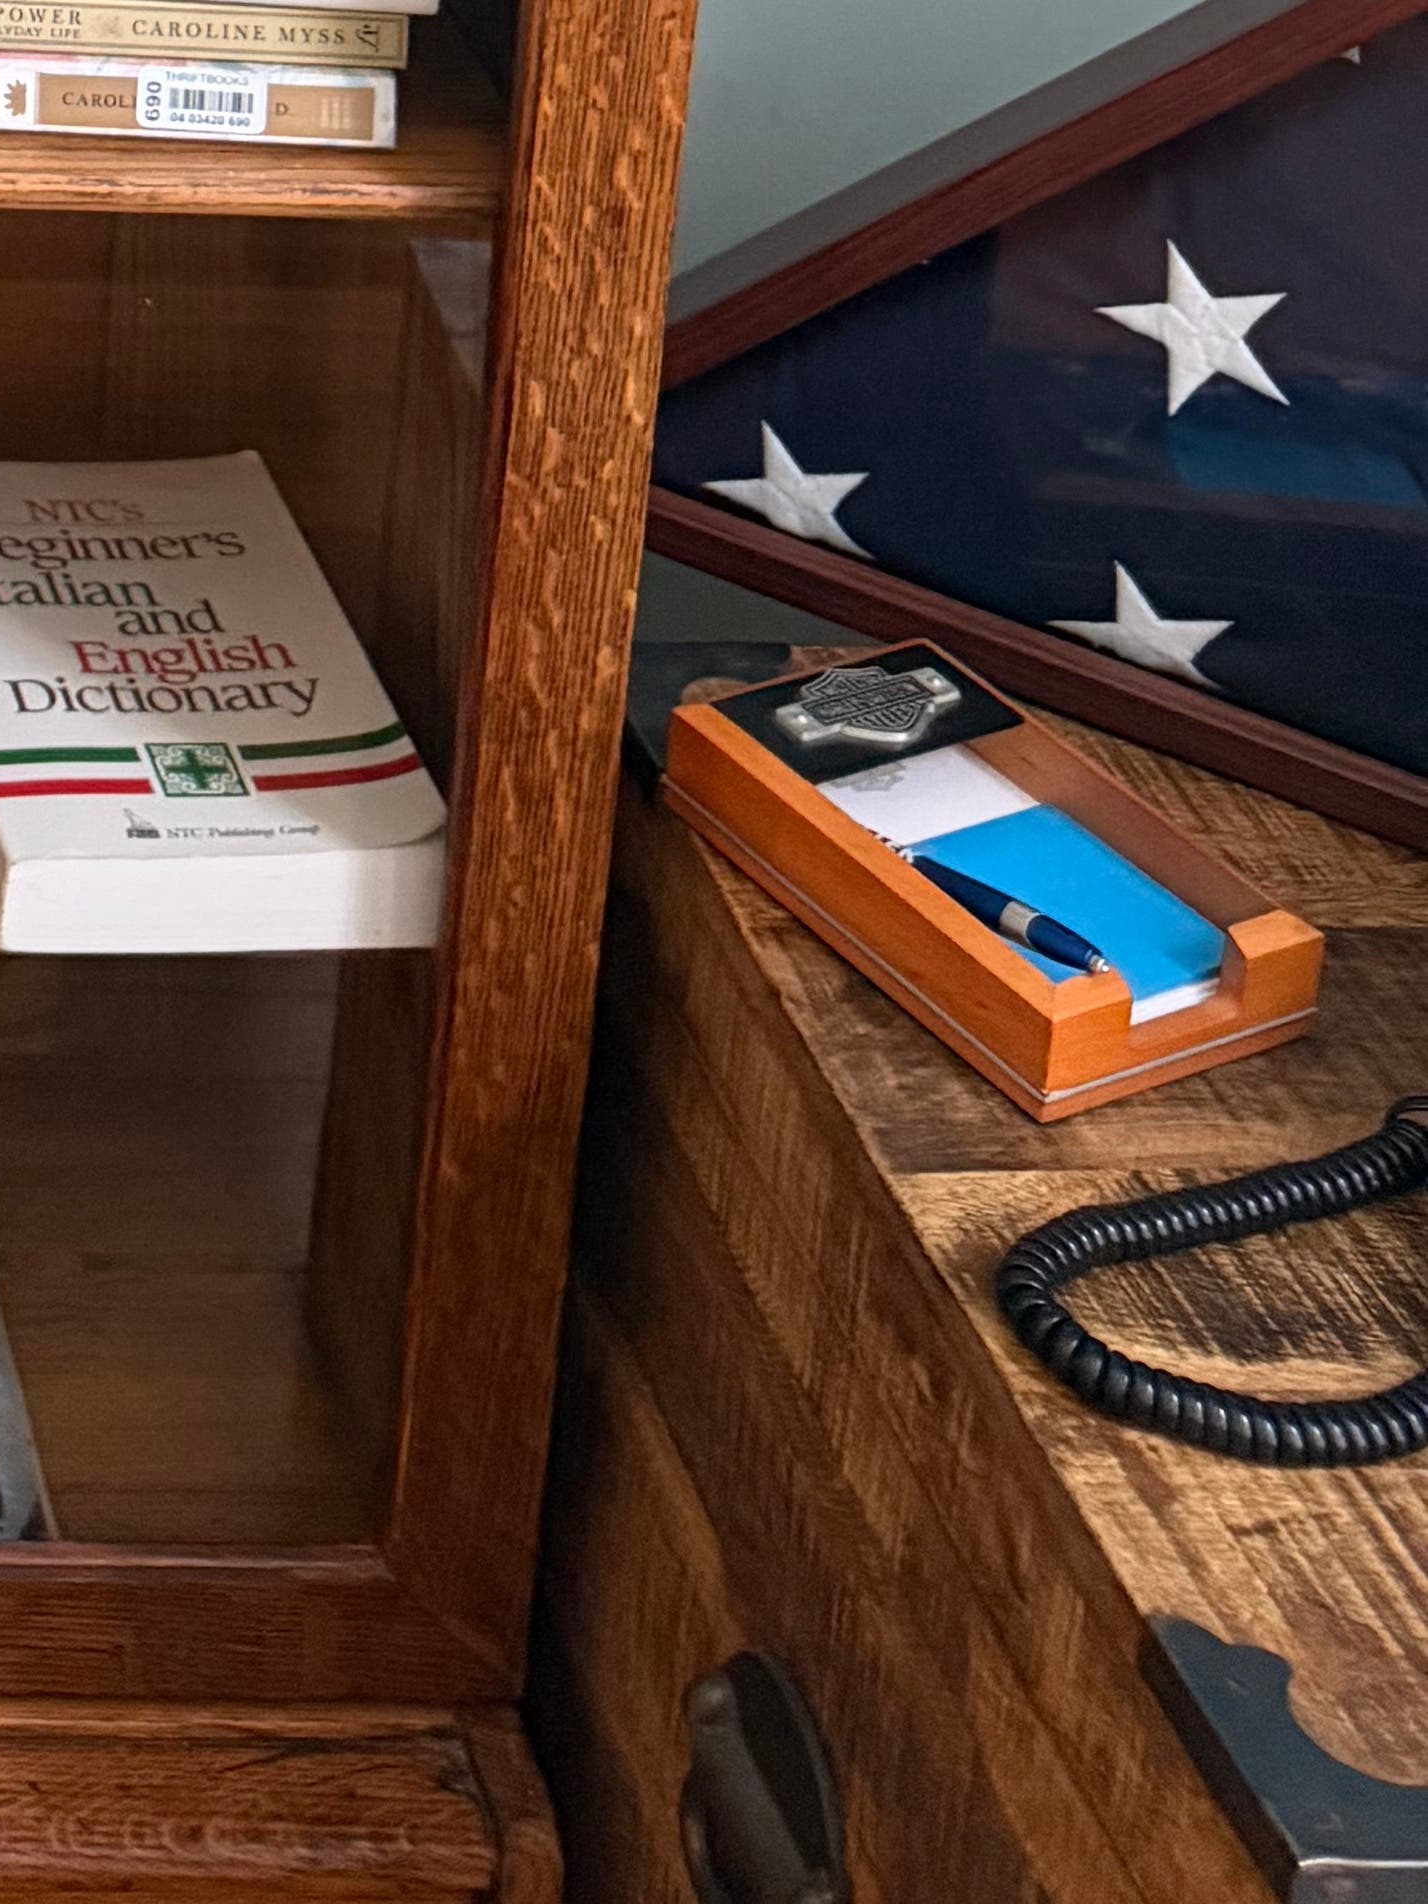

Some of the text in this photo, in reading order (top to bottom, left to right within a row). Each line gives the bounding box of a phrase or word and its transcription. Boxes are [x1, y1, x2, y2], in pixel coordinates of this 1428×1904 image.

[49, 26, 82, 40] LIFE
[132, 18, 345, 46] CAROLINE MYSS
[165, 70, 250, 87] THRIFTBOOKS
[145, 80, 162, 121] 690
[25, 497, 144, 523] NTC's
[116, 599, 226, 637] and
[70, 636, 297, 685] English
[5, 677, 321, 717] Dictionary
